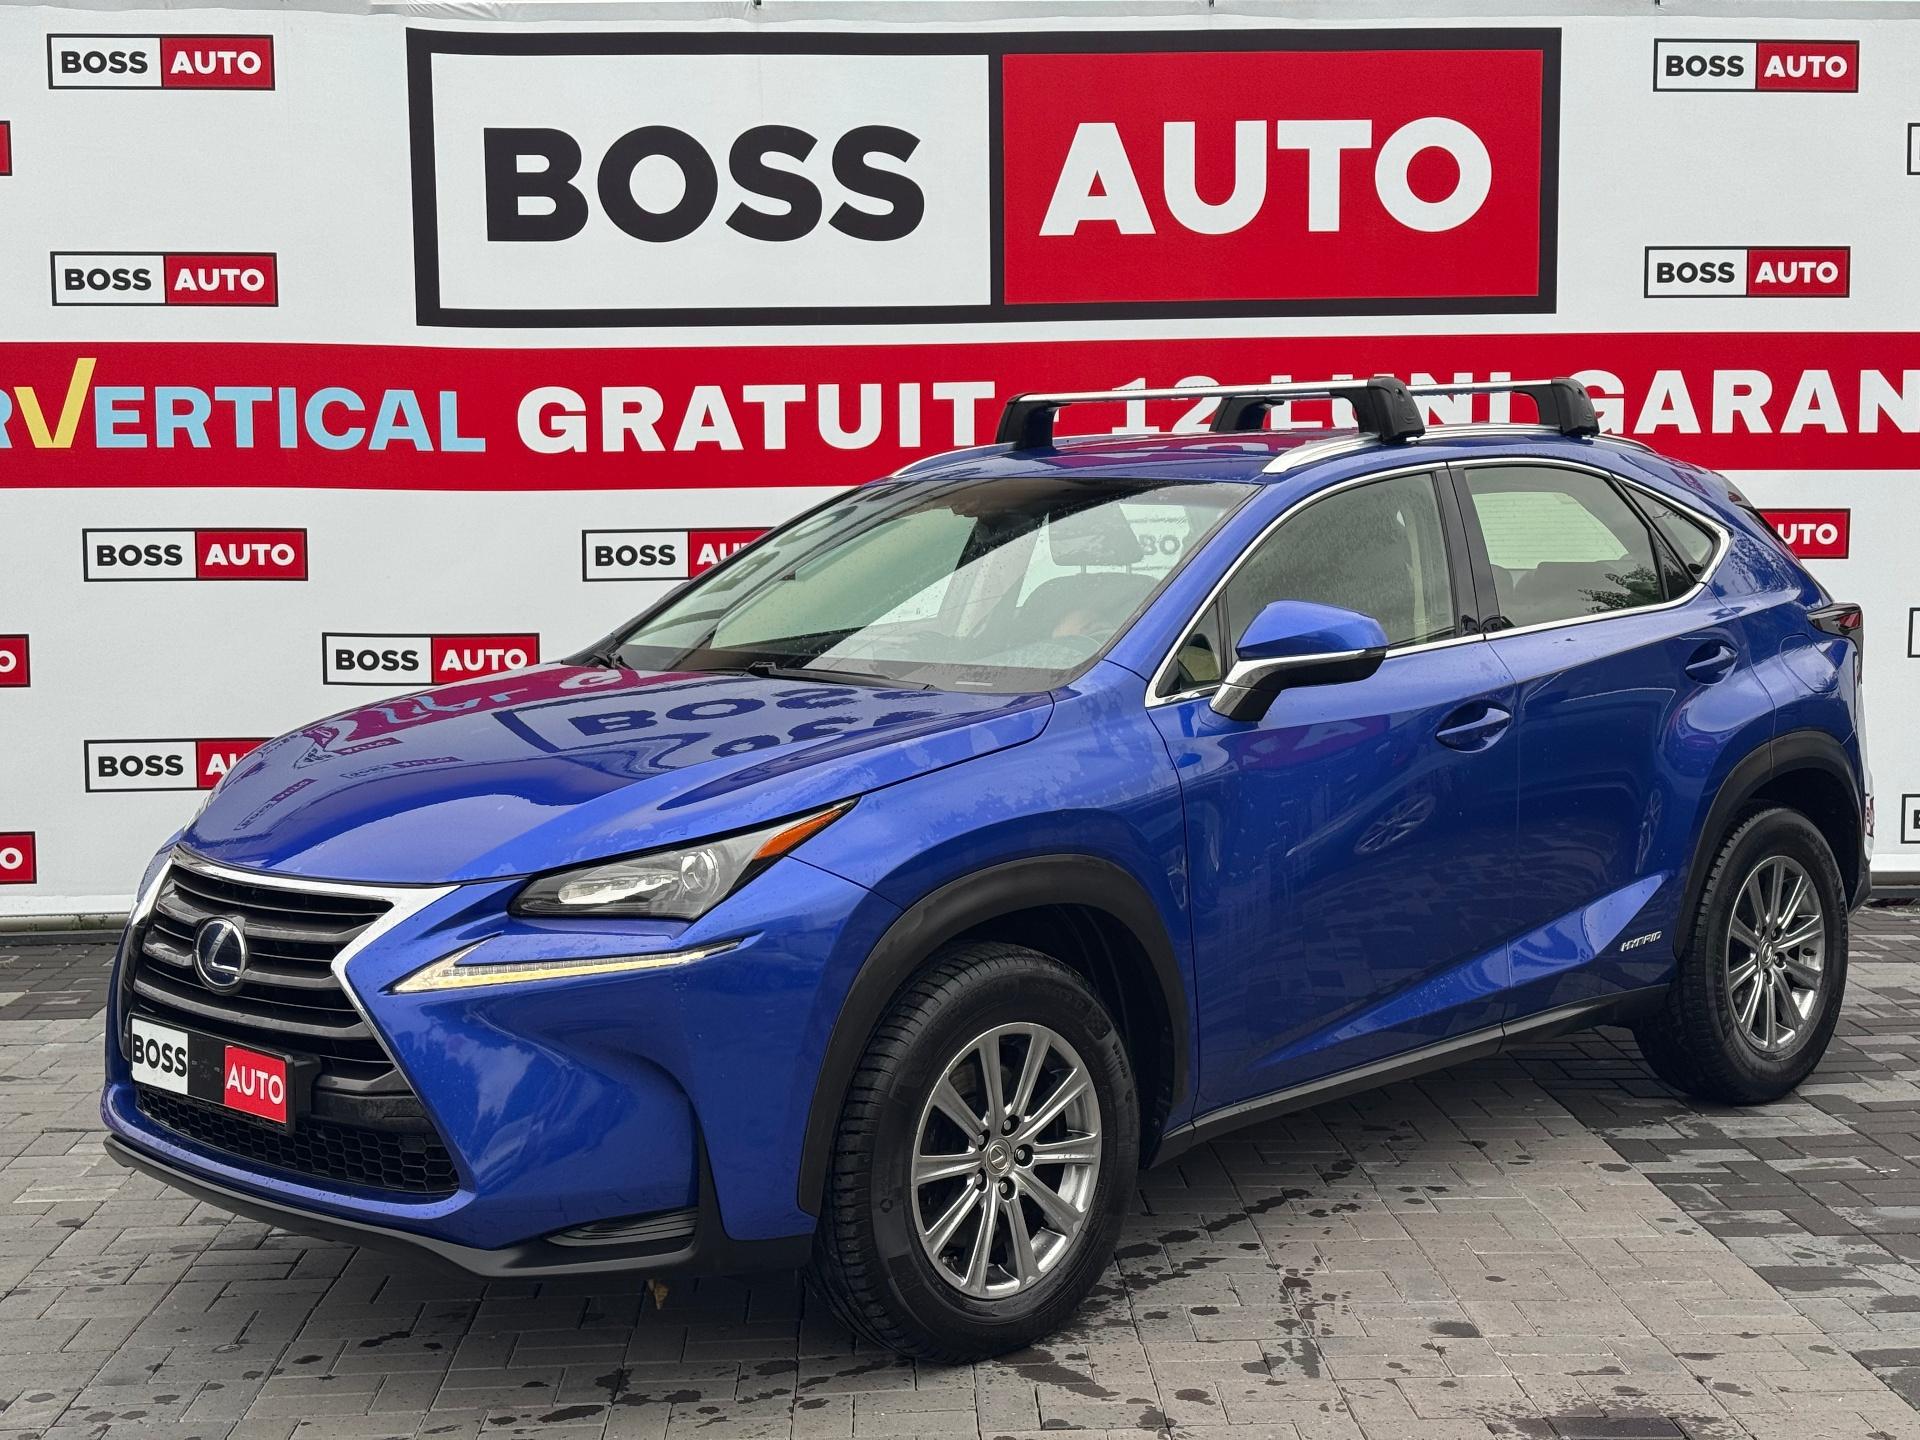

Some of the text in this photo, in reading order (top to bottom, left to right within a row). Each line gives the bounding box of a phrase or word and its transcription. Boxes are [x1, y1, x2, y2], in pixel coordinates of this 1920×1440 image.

[61, 51, 263, 75] BOSS AUTO
[1666, 56, 1849, 78] BOSS AUTO
[484, 117, 1493, 243] BOSS AUTO
[65, 268, 265, 292] BOSS AUTO
[1656, 262, 1840, 284] BOSS AUTO
[0, 357, 487, 453] VERTICAL
[517, 381, 996, 453] GRATUIT
[1112, 375, 1222, 434] 12
[1777, 523, 1839, 545] UTO
[97, 543, 296, 568] BOSS AUTO
[595, 542, 753, 567] BOSS AU
[335, 648, 529, 672] BOSS AUTO
[98, 754, 184, 778] BOSS
[132, 1033, 284, 1105] BOSS AUTO
